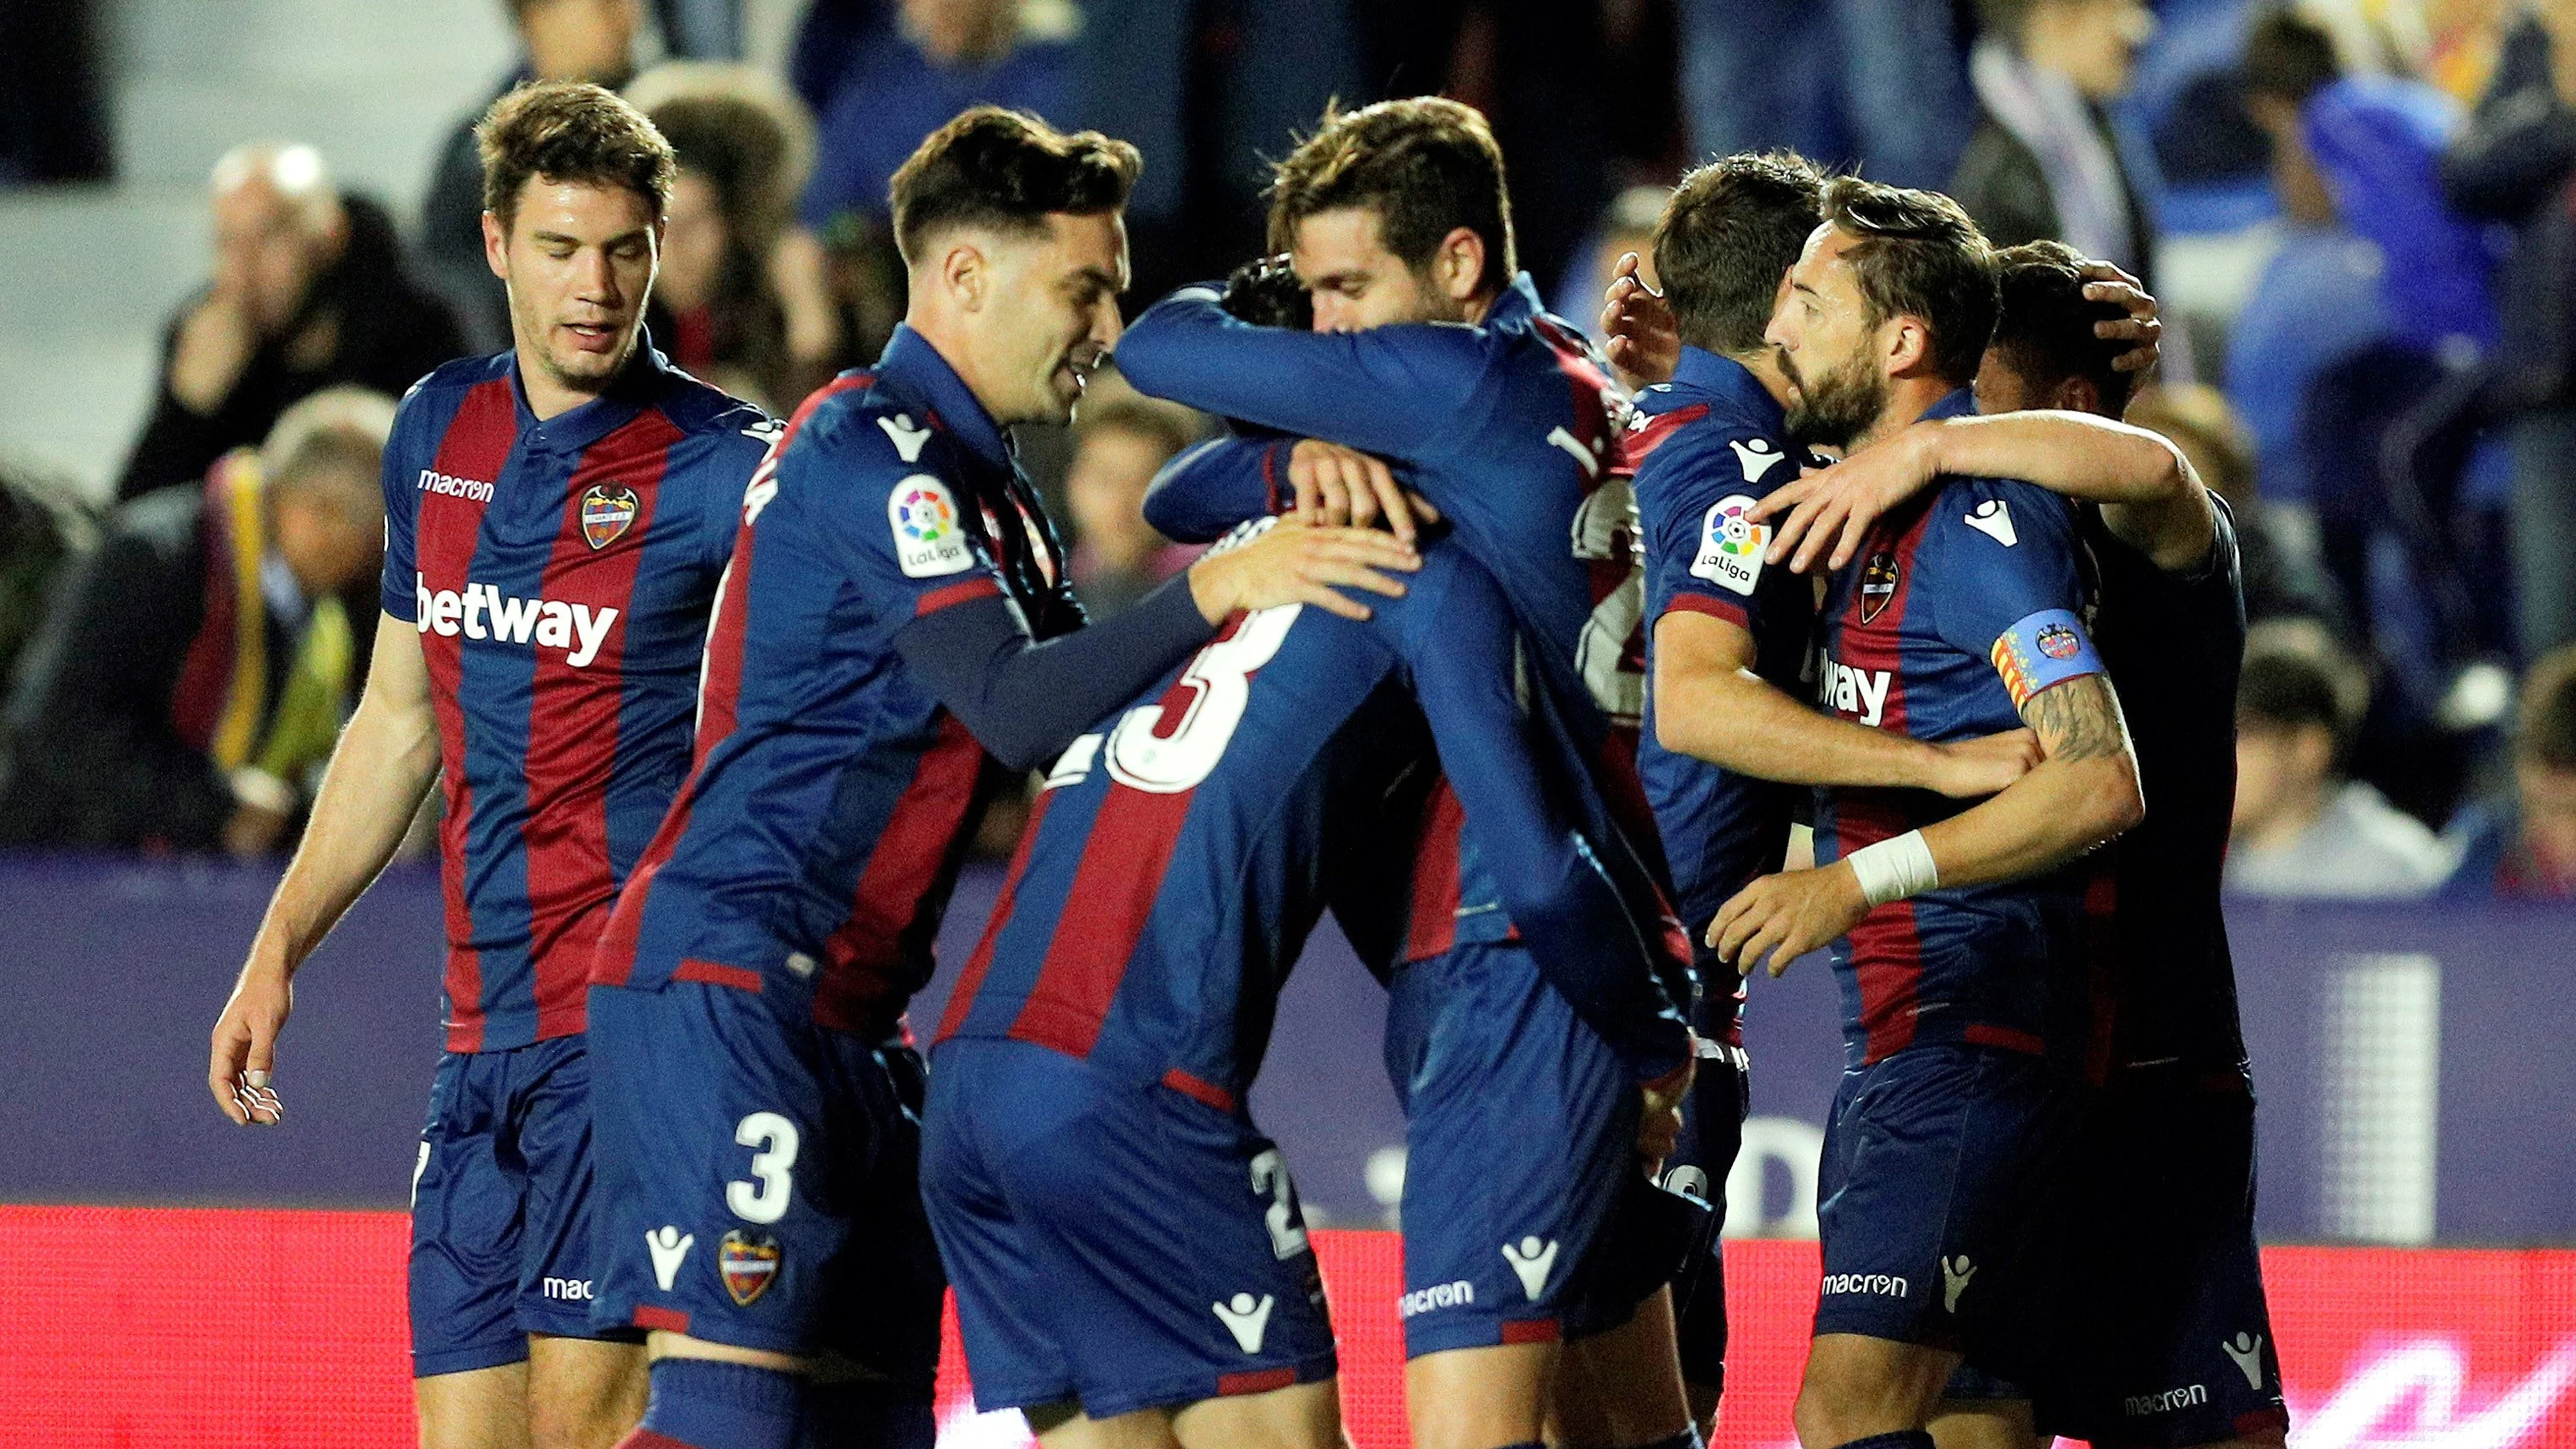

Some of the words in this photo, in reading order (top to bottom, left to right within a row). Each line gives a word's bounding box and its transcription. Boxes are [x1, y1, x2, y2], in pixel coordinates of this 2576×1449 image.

[416, 470, 495, 503] macron
[908, 545, 960, 567] LaLiga
[1702, 555, 1751, 581] LaLiga
[416, 571, 620, 668] betway
[725, 1112, 799, 1223] 3
[1821, 1274, 1908, 1297] macron
[2125, 1384, 2208, 1416] macron
